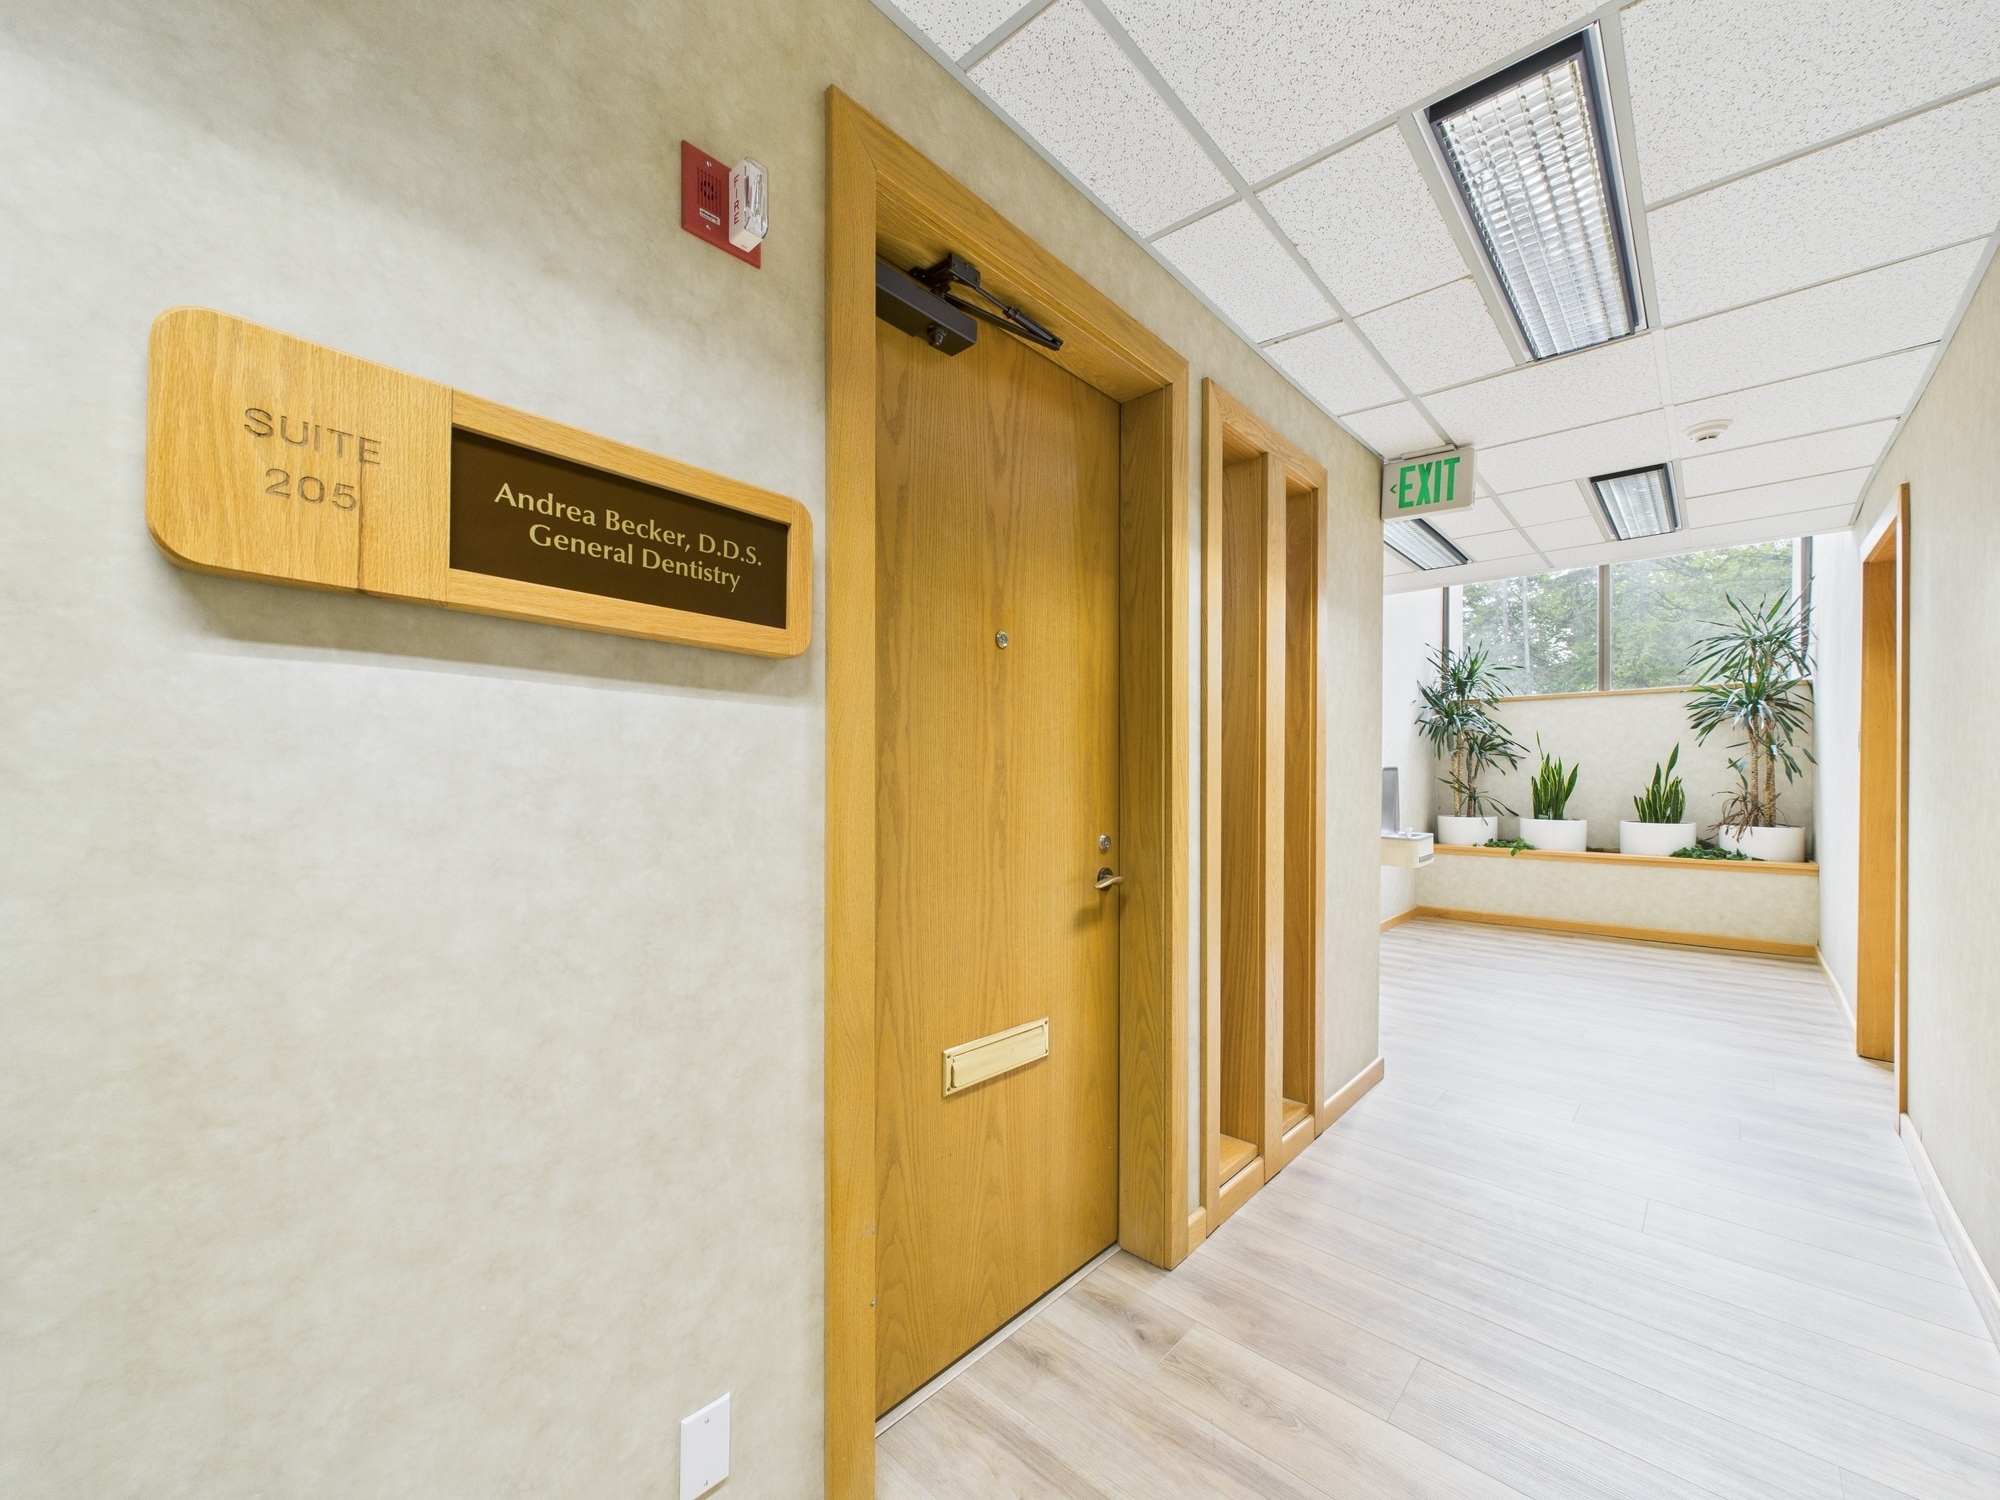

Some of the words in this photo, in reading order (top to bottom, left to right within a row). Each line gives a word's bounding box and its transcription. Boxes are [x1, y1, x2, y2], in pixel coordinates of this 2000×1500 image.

[244, 407, 382, 466] SUITE
[265, 468, 357, 511] 205
[1398, 456, 1461, 509] EXIT
[494, 482, 597, 527] Andrea
[605, 509, 691, 552] Becker,
[699, 533, 763, 566] D.D.S.
[529, 523, 633, 566] General
[642, 548, 741, 593] Dentistry
